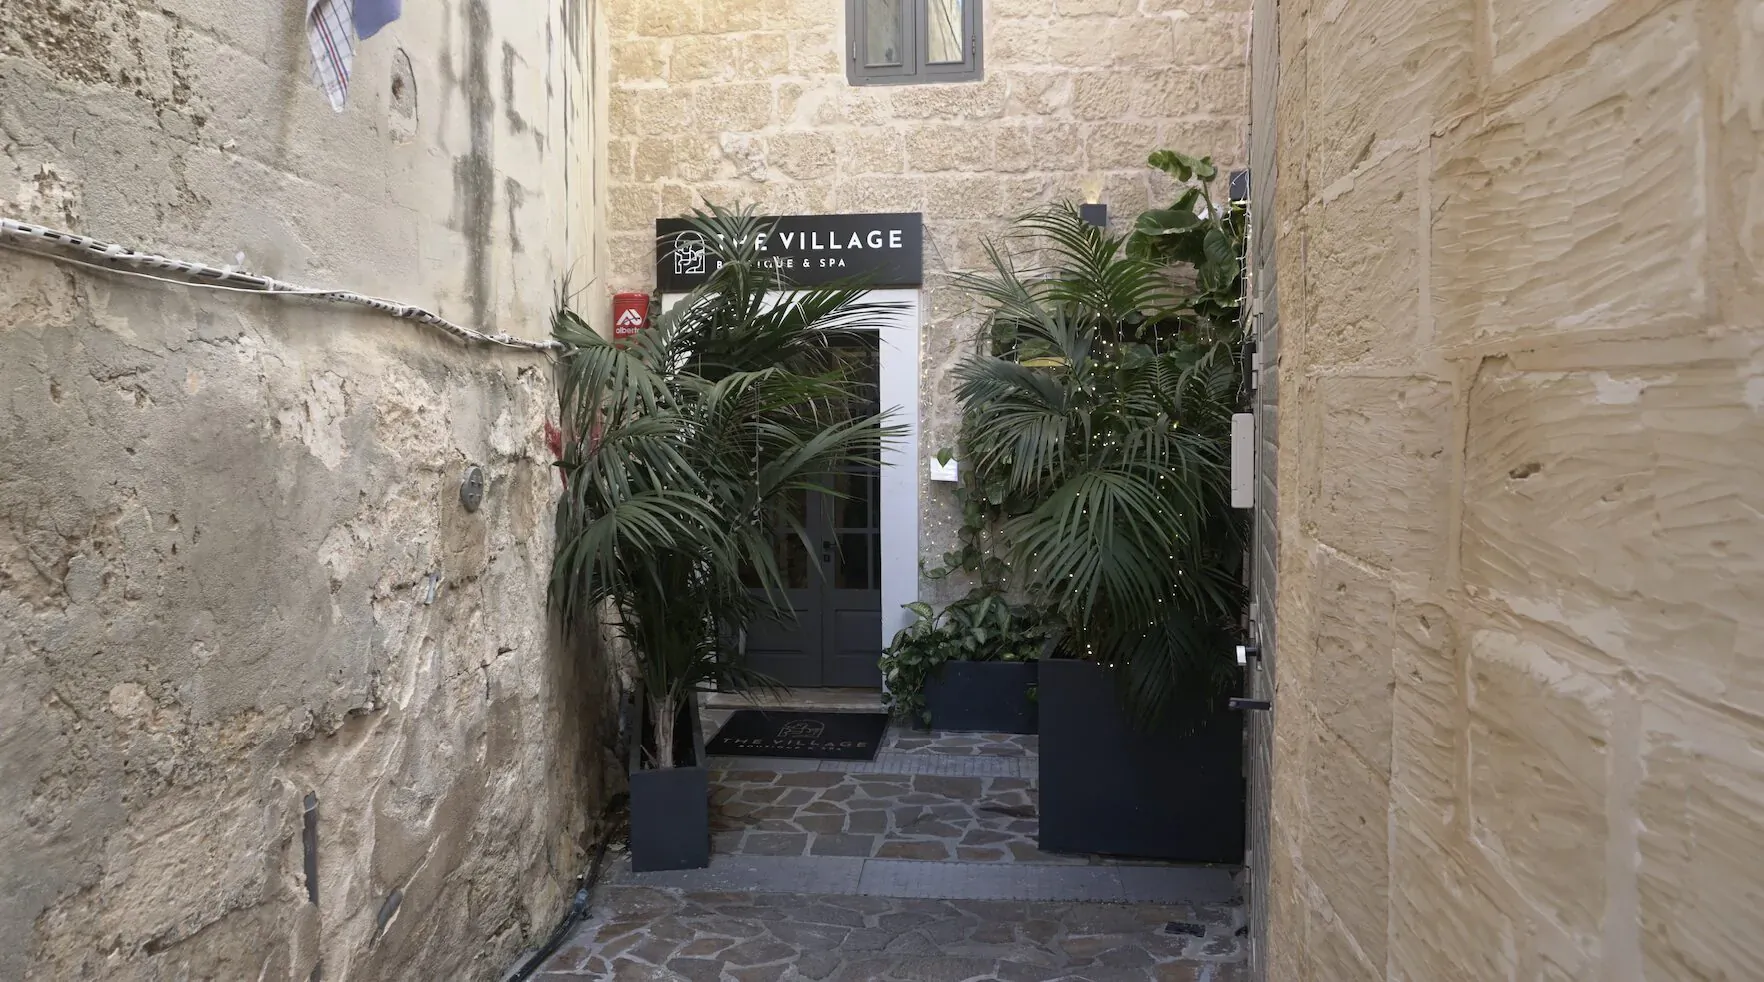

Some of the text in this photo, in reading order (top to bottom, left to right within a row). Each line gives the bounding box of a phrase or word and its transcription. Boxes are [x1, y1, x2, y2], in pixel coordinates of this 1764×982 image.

[779, 230, 903, 250] VILLAGE
[802, 259, 810, 268] &
[819, 259, 846, 267] SPA
[773, 739, 868, 748] VILLAGE
